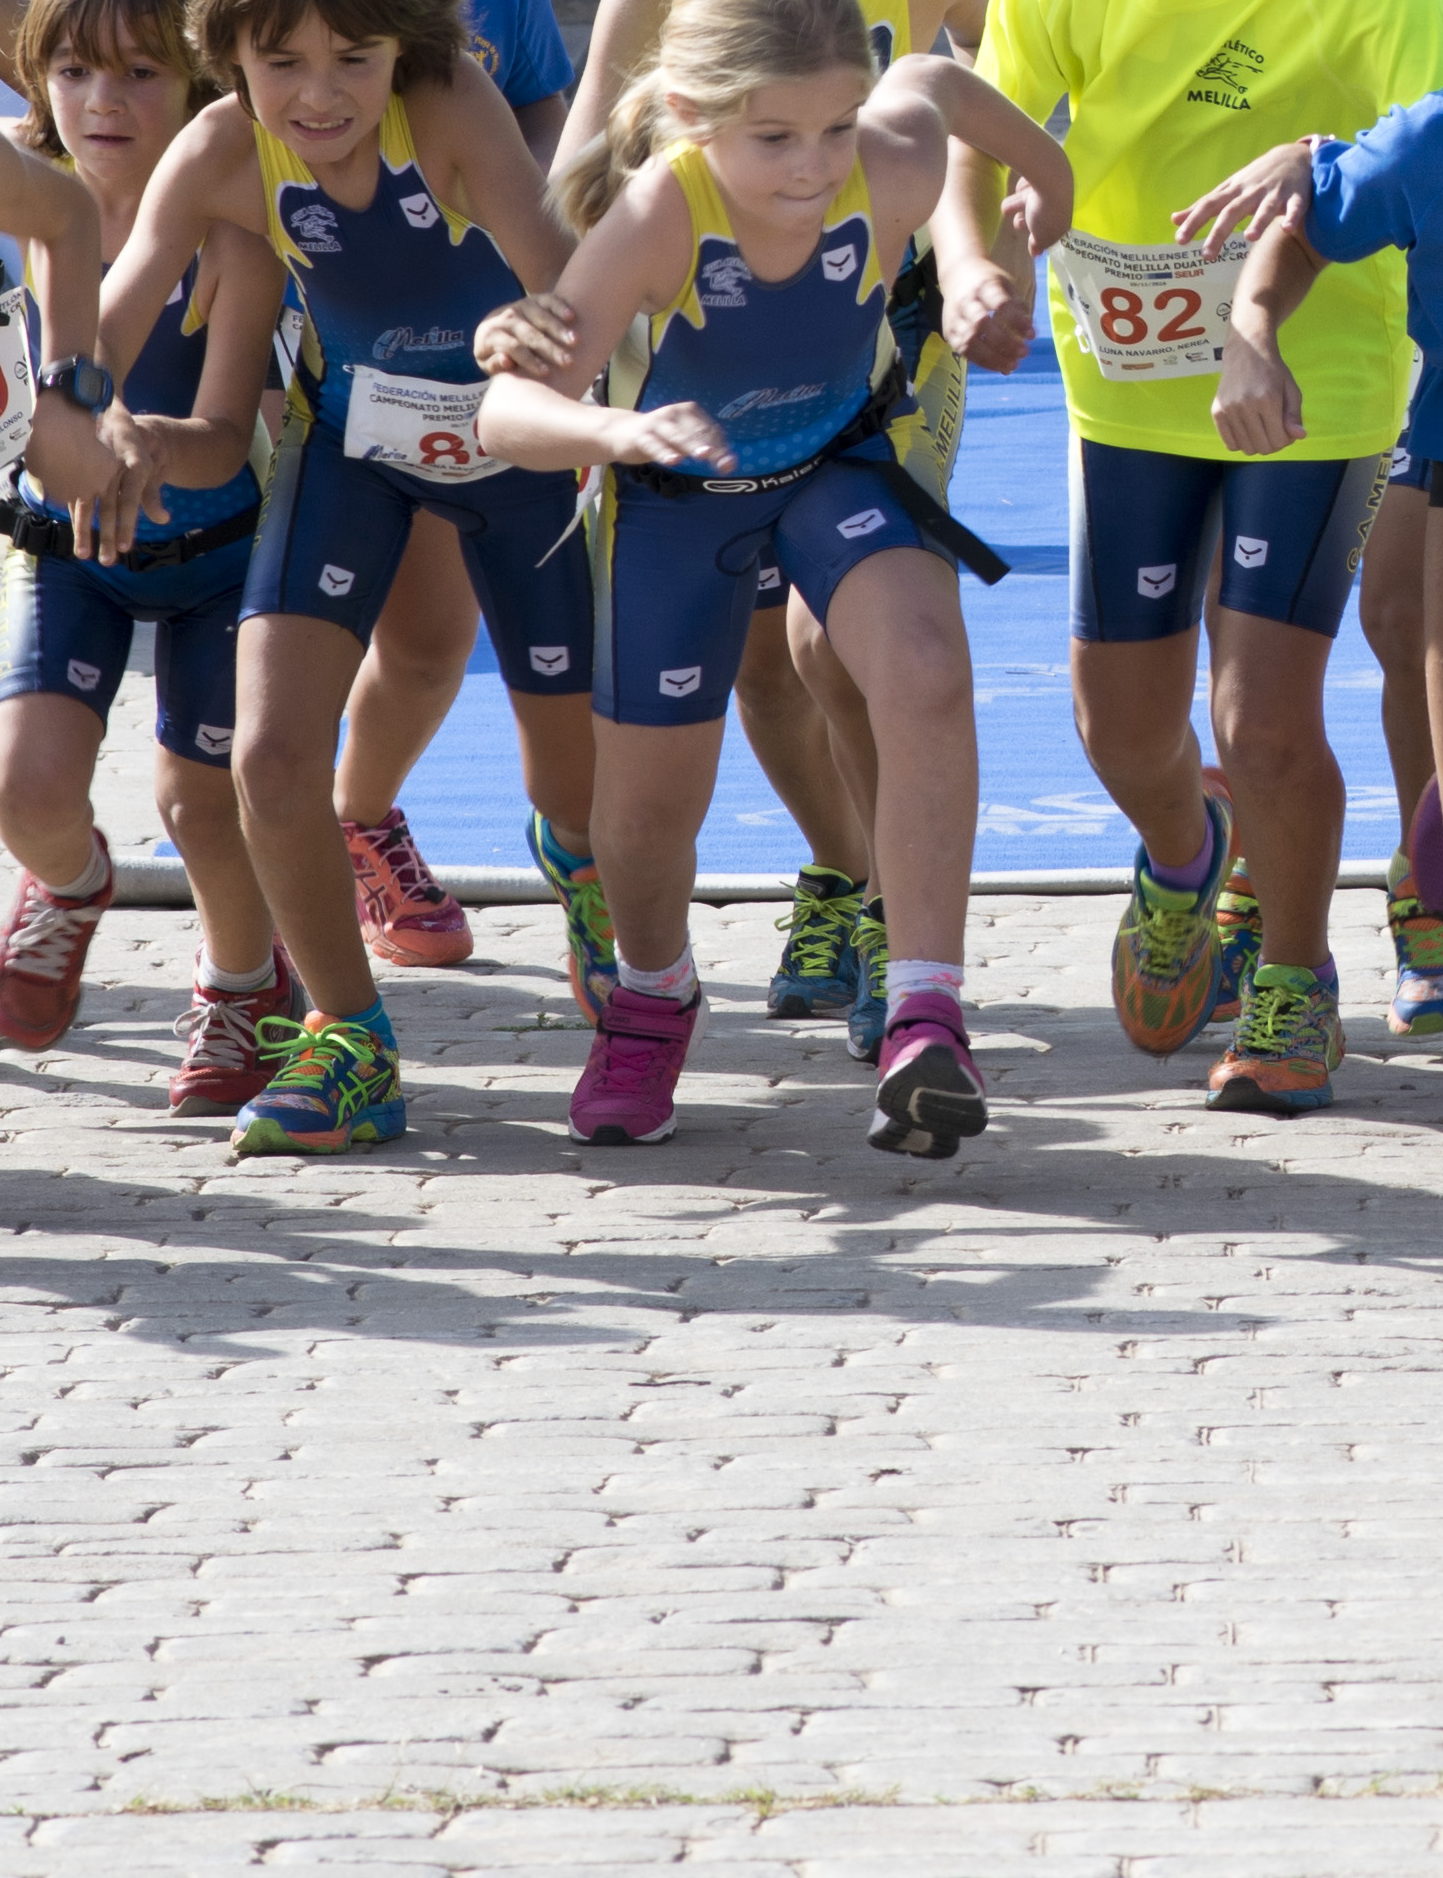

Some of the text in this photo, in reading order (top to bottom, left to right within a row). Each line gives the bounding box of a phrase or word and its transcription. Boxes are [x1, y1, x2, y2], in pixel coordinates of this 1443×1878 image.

[1187, 90, 1251, 110] MELILLA
[1060, 238, 1170, 271] CAMPEONATO MELILLA
[1120, 251, 1188, 262] MELILLENSE
[1105, 266, 1204, 280] PREMIO SEUR
[1100, 287, 1206, 345] 82
[1099, 346, 1124, 357] LUNA
[1177, 339, 1210, 350] NEREA
[373, 382, 436, 402] FEDERACIÓN
[370, 394, 440, 412] CAMPEONATO
[419, 418, 488, 464] 8
